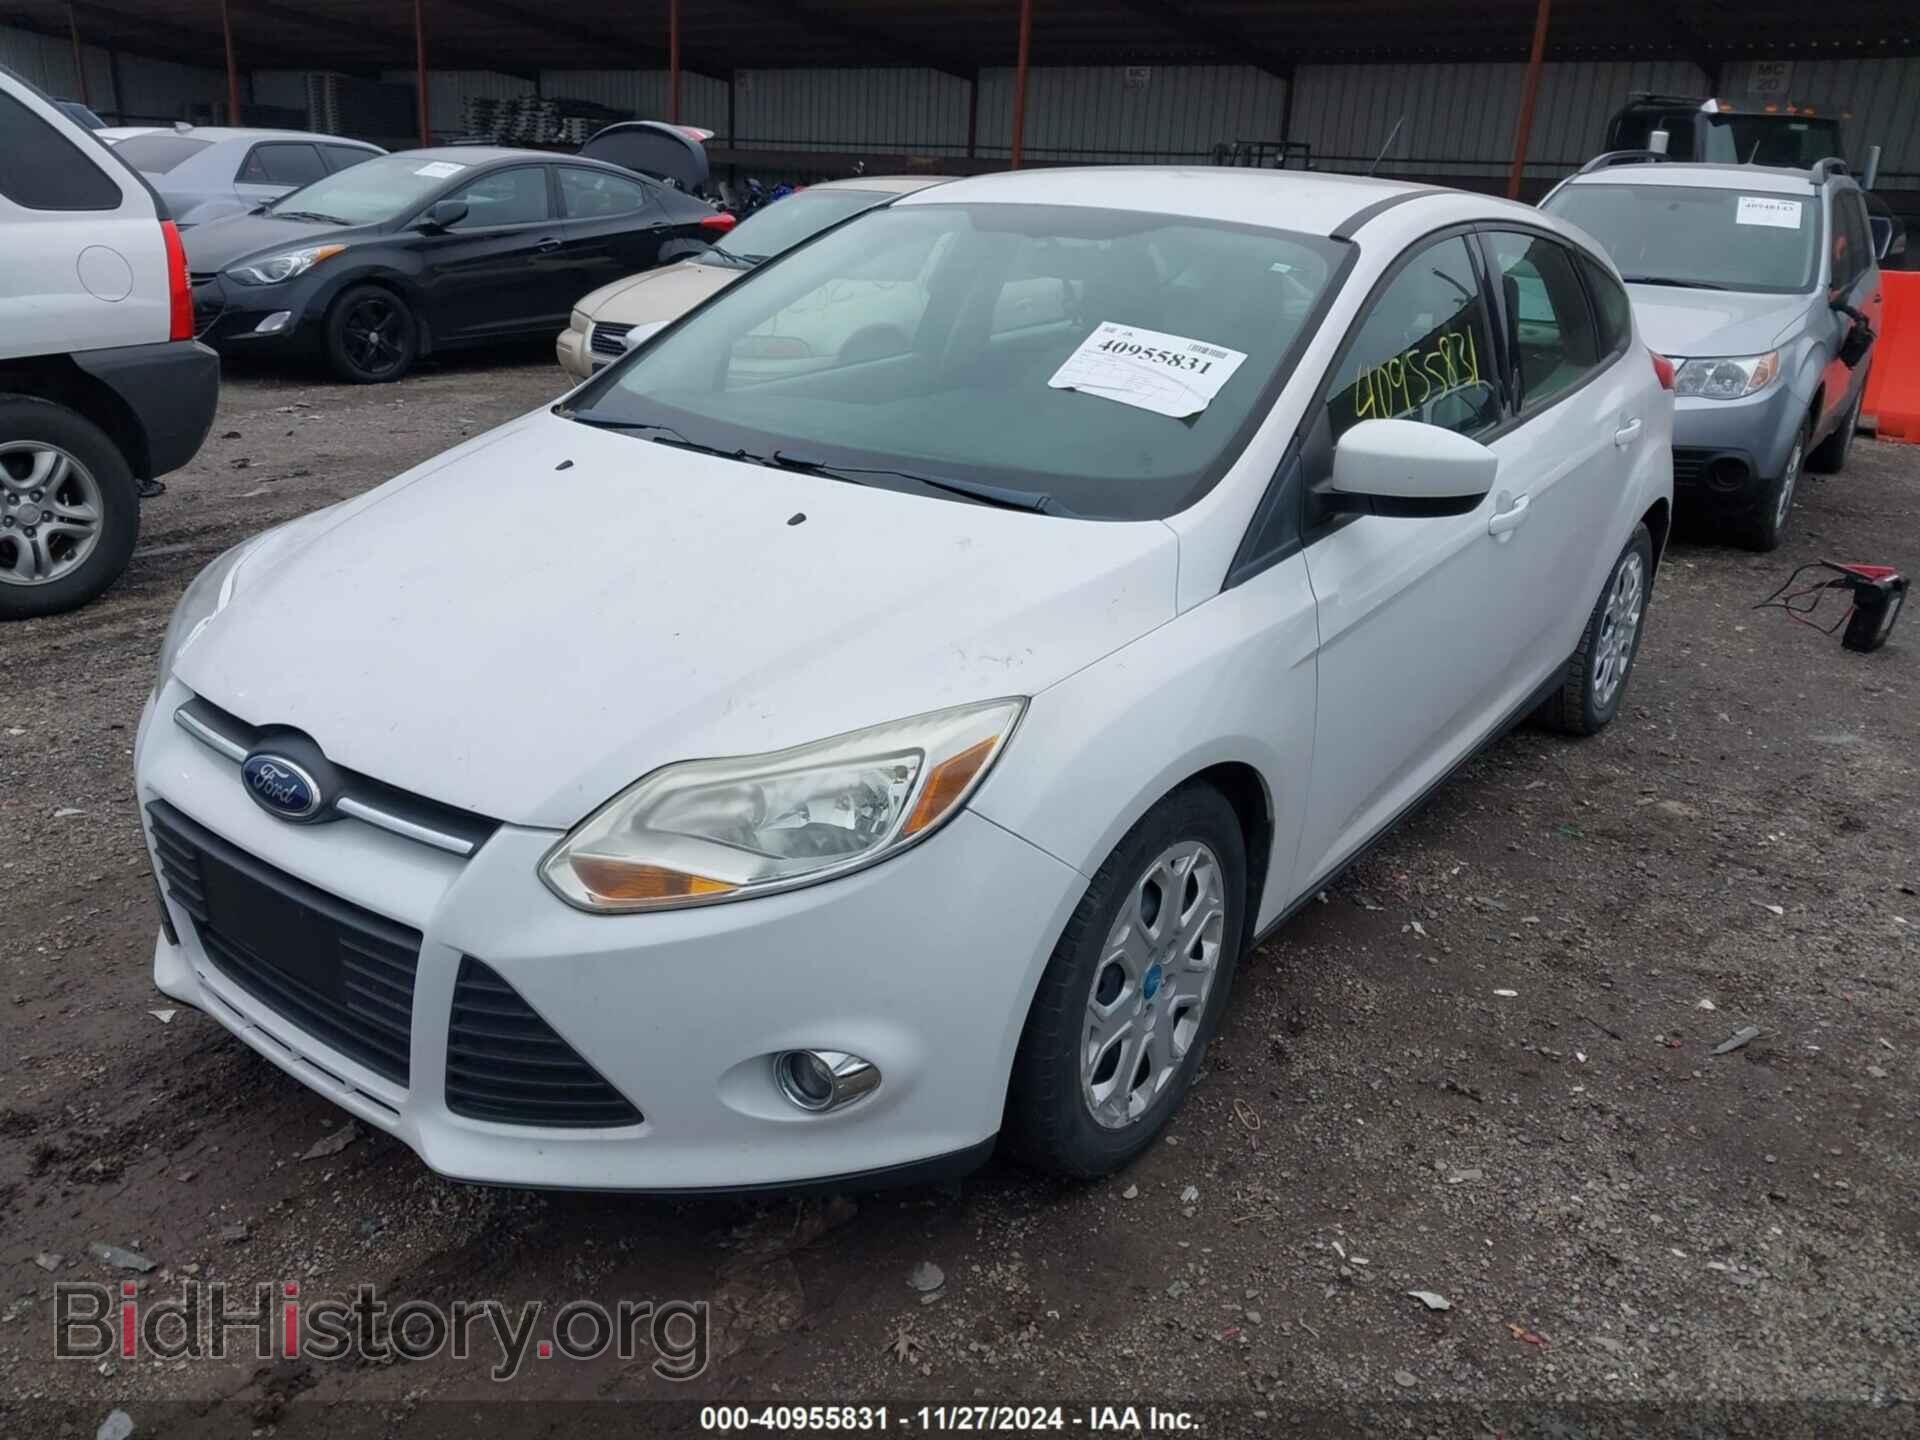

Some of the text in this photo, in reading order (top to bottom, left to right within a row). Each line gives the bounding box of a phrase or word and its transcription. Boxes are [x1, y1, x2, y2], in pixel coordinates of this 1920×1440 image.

[1098, 339, 1212, 374] 40955831
[1356, 325, 1480, 420] 40955831
[255, 763, 297, 804] Ford
